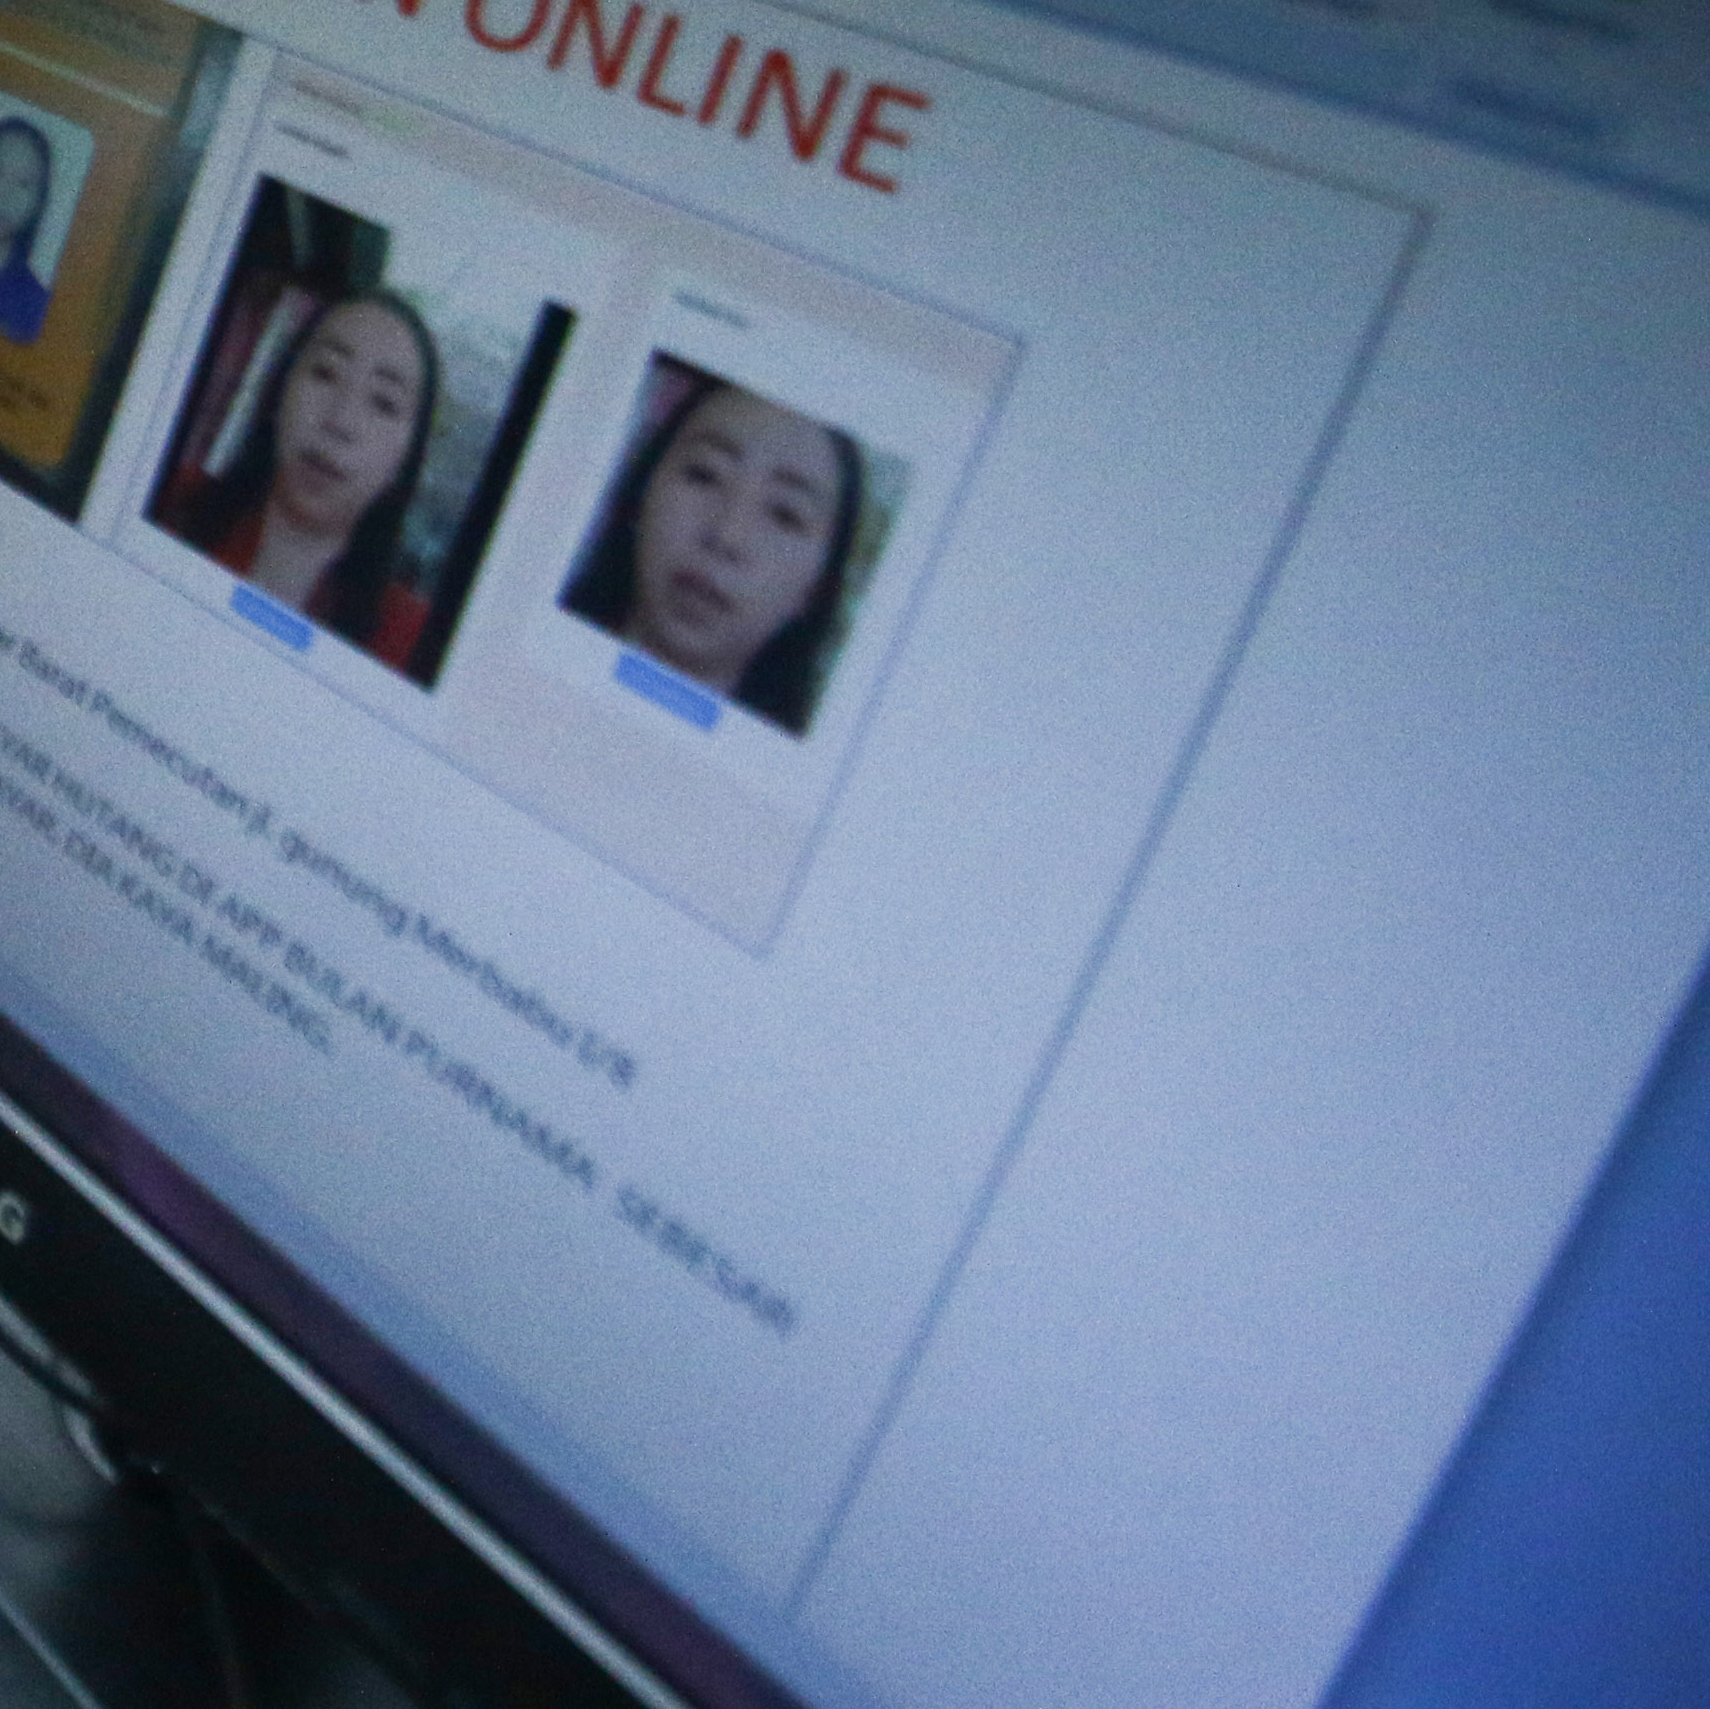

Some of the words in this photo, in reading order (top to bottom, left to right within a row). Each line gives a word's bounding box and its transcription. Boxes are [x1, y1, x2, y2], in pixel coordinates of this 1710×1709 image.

[48, 763, 181, 880] HUTANG
[280, 936, 403, 1046] BULAN
[397, 1023, 605, 1196] PURNAMA
